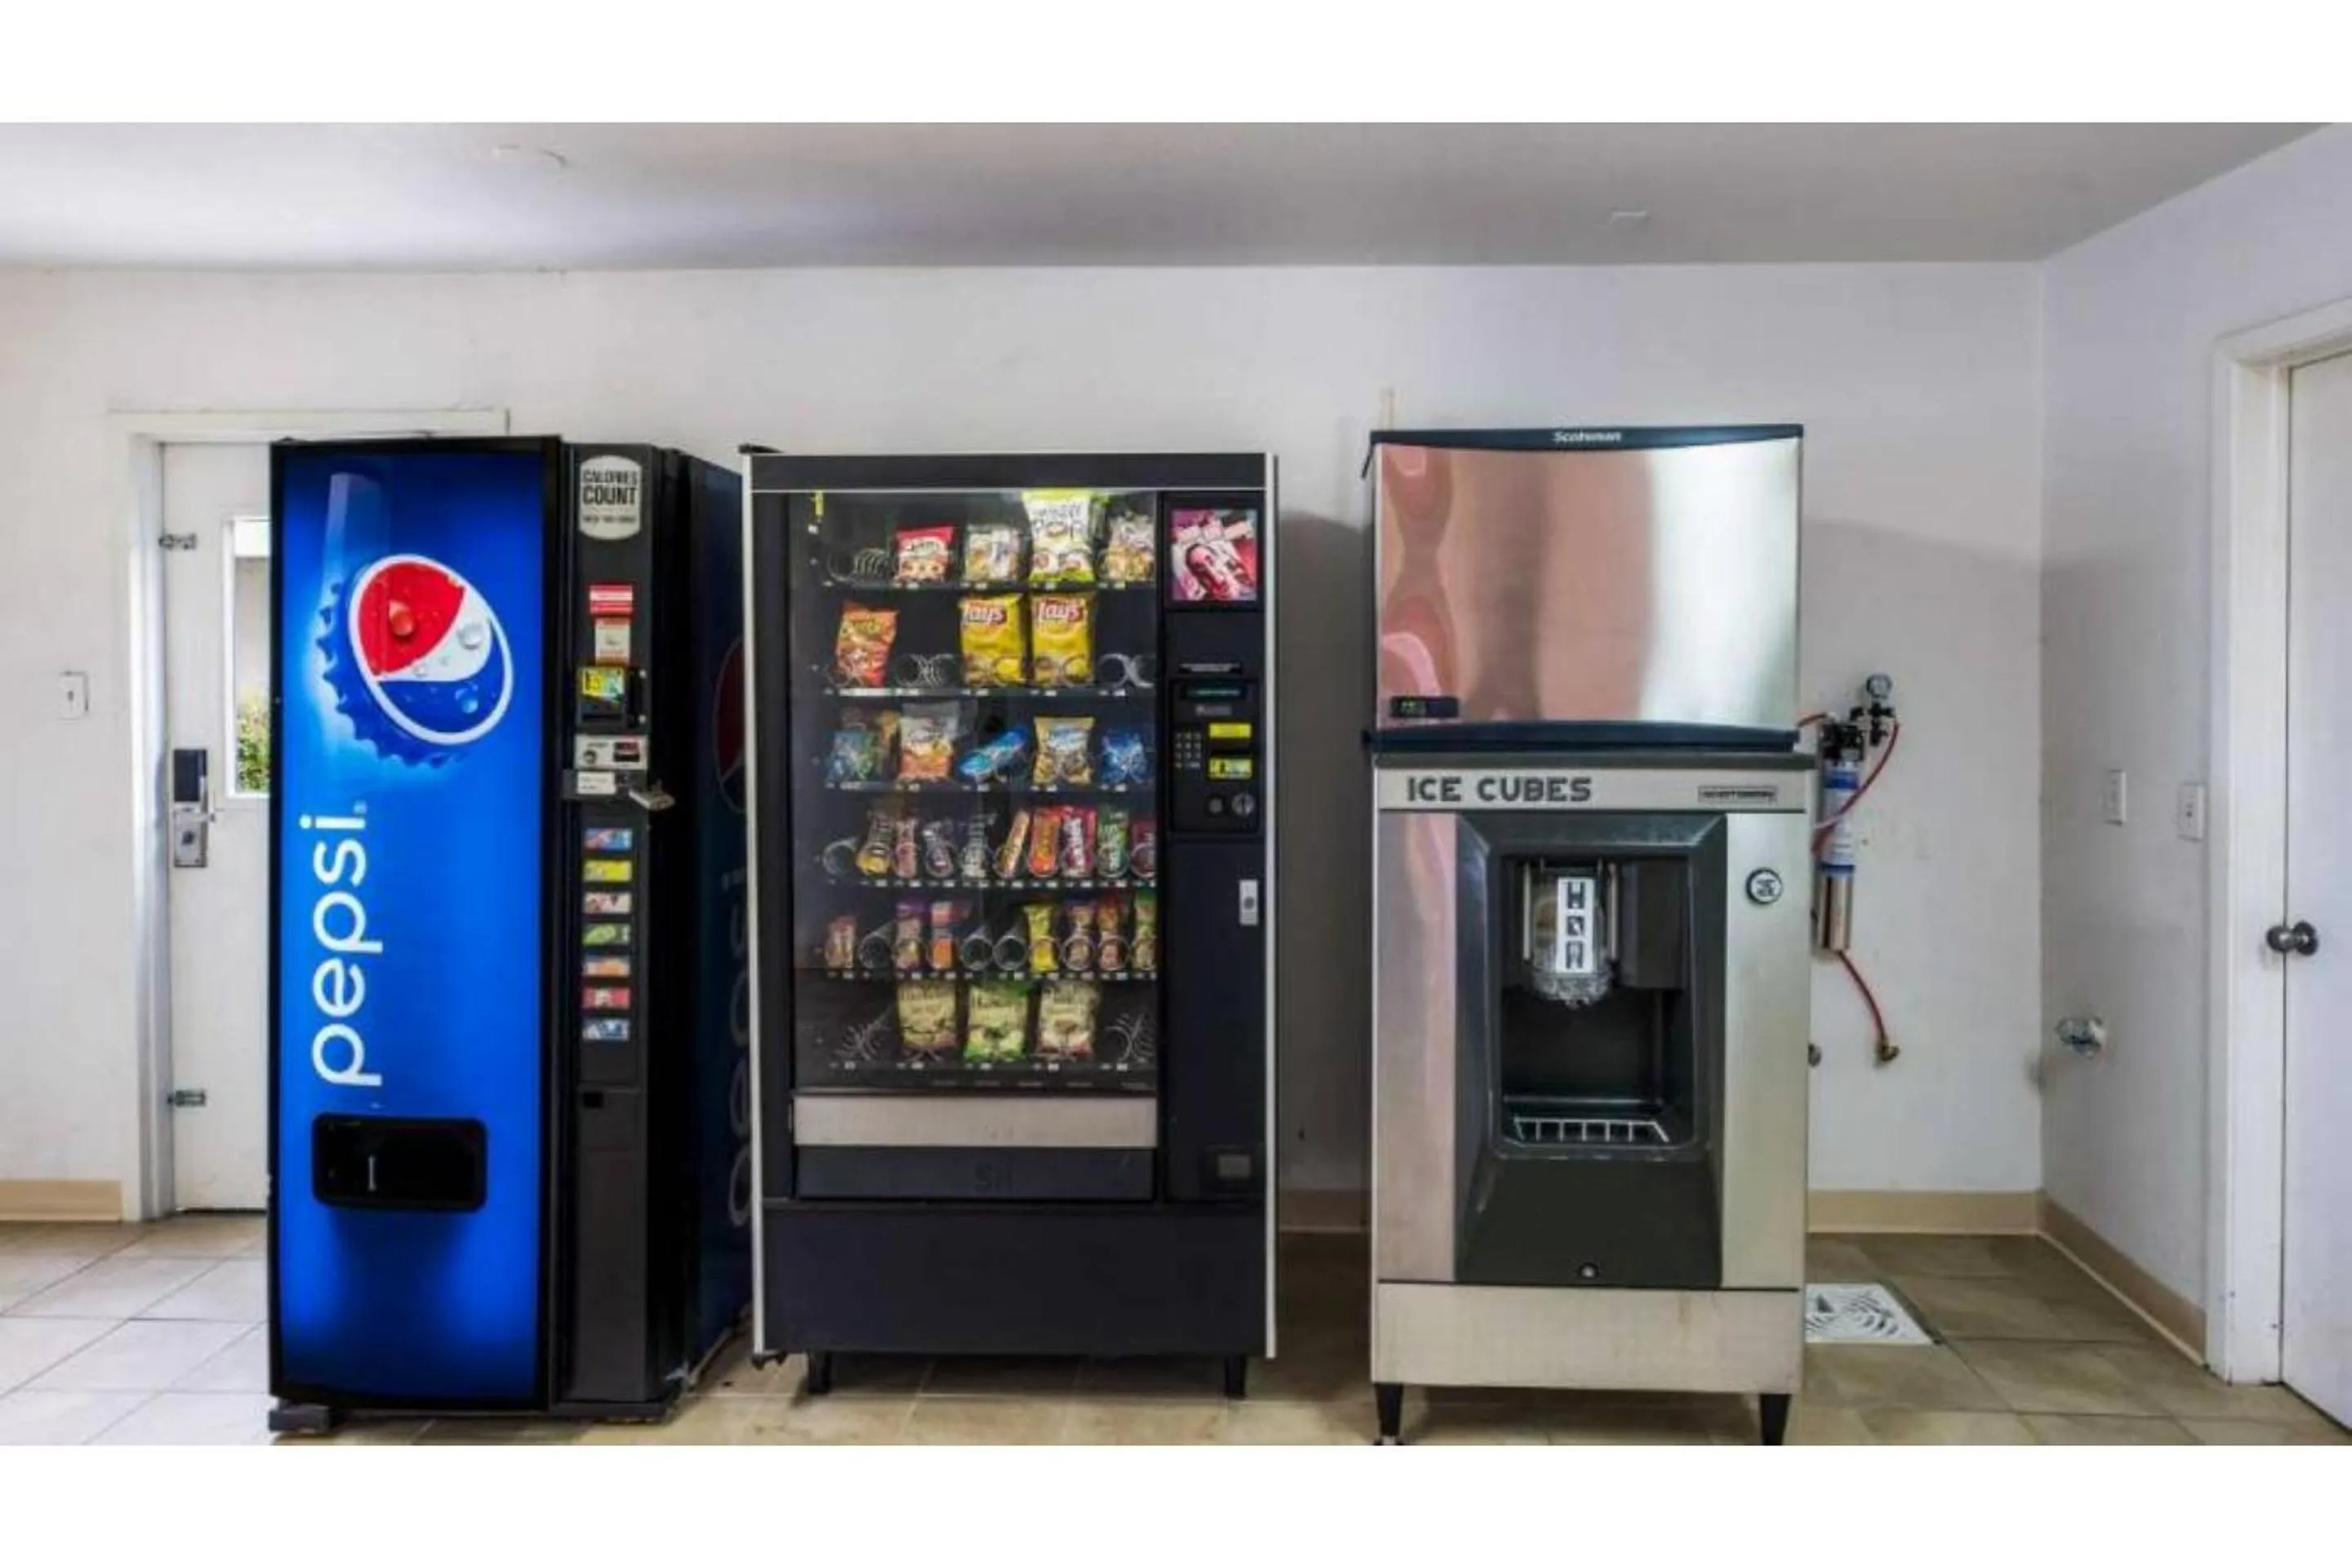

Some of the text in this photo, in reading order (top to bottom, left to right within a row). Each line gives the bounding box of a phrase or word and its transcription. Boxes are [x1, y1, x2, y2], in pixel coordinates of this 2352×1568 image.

[582, 484, 637, 506] COUNT
[1407, 776, 1592, 802] ICE CUBES
[299, 814, 384, 1088] pepsi
